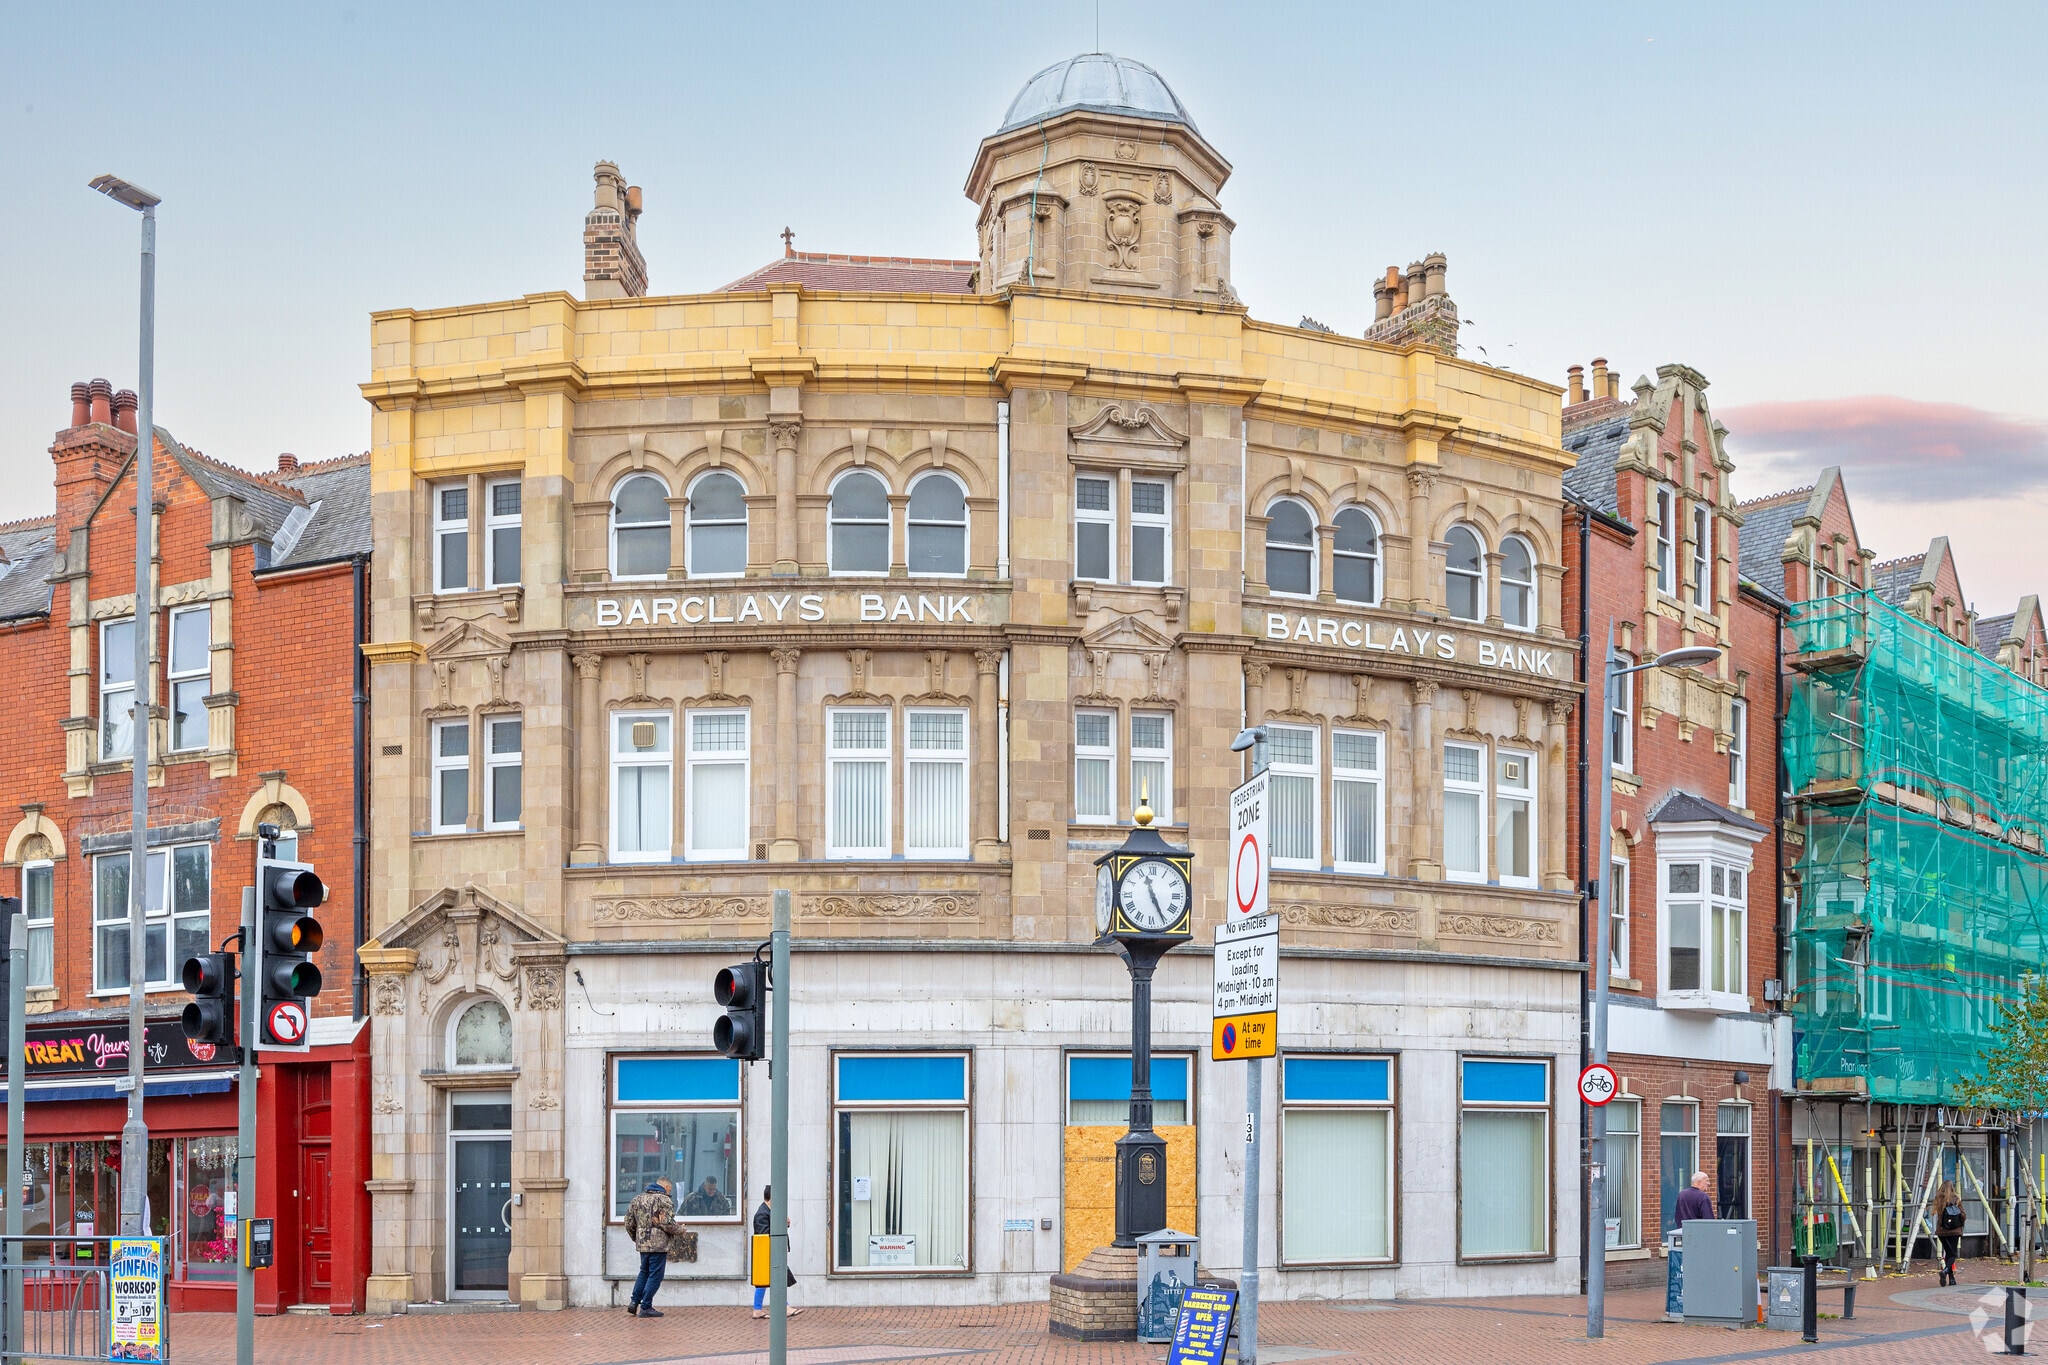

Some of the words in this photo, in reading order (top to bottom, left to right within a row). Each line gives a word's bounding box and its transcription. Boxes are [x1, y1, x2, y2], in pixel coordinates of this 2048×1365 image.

[596, 594, 826, 627] BARCLAYS
[860, 594, 974, 624] BANK
[1266, 612, 1457, 660] BARCLAYS
[1478, 640, 1554, 676] BANK
[1233, 778, 1265, 808] PEDESTRIAN
[1237, 800, 1260, 831] ZONE
[1226, 923, 1236, 934] No
[1238, 917, 1267, 931] vehicles
[1227, 946, 1252, 961] Except
[1253, 945, 1264, 957] for
[1231, 963, 1259, 976] loading
[1263, 978, 1274, 988] am
[1217, 997, 1223, 1009] 4
[1242, 1021, 1251, 1033] At
[1252, 1022, 1266, 1035] any
[1245, 1037, 1262, 1049] time
[24, 1038, 84, 1065] TREAT
[1245, 1113, 1253, 1143] 134
[122, 1246, 149, 1257] FAMILY
[112, 1259, 159, 1279] FUNFAIR
[115, 1281, 157, 1294] WORKSOP
[1183, 1300, 1213, 1310] BARBERS
[1213, 1303, 1231, 1312] SHOP
